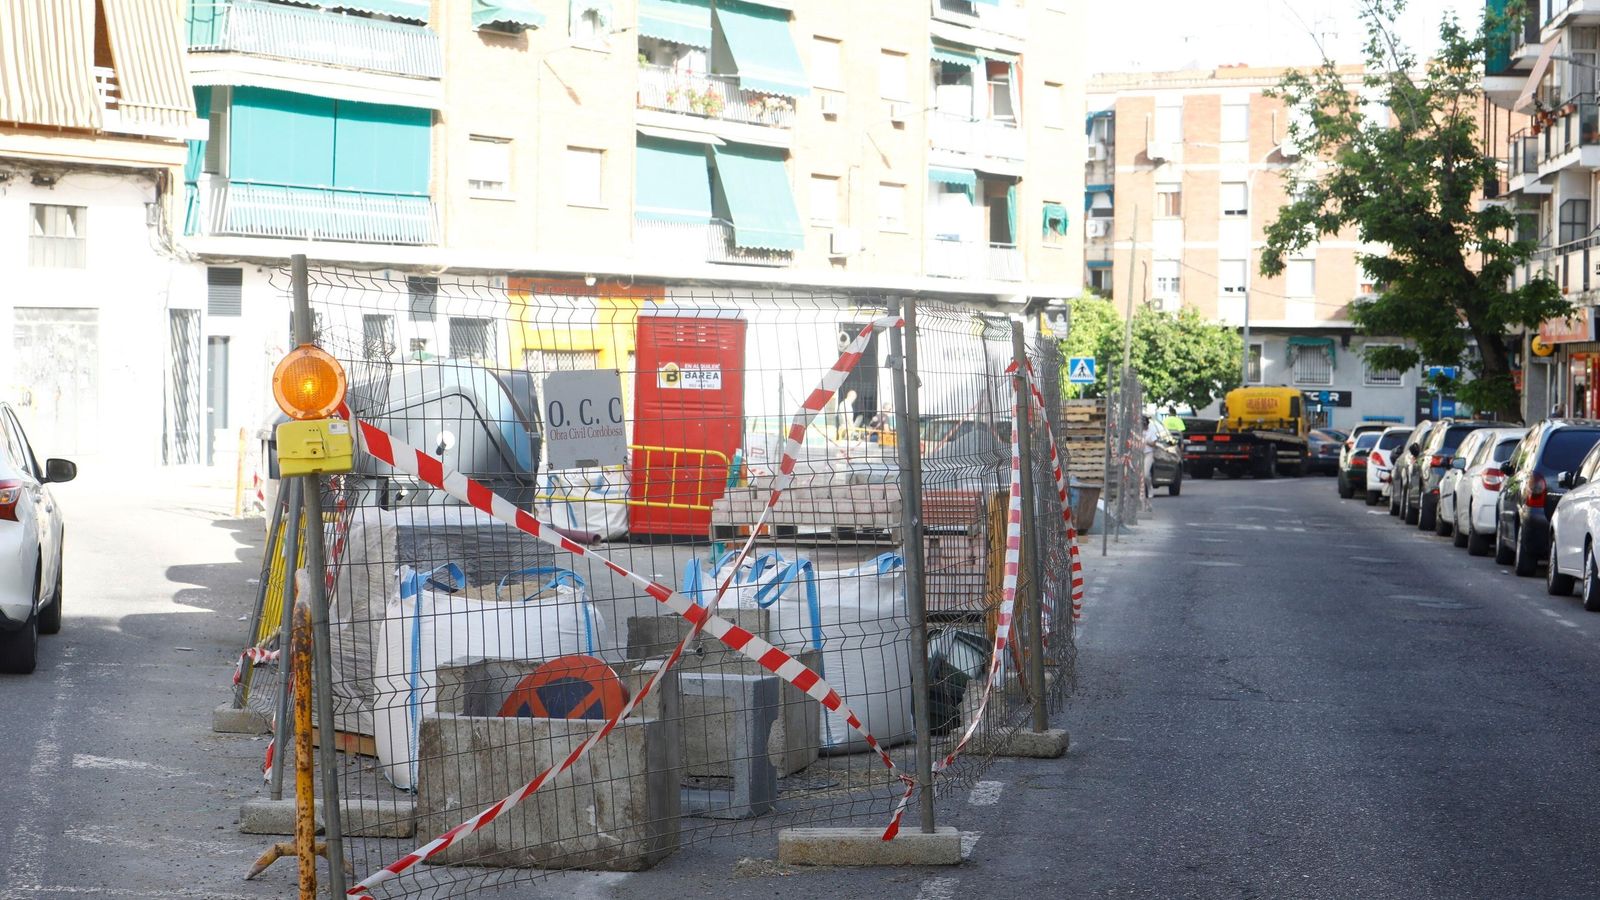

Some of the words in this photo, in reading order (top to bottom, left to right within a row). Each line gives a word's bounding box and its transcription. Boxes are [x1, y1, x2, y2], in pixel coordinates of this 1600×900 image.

[684, 370, 719, 380] BAREA
[550, 428, 568, 440] Obra
[569, 426, 586, 439] Civil
[587, 425, 623, 438] Cordobesa
